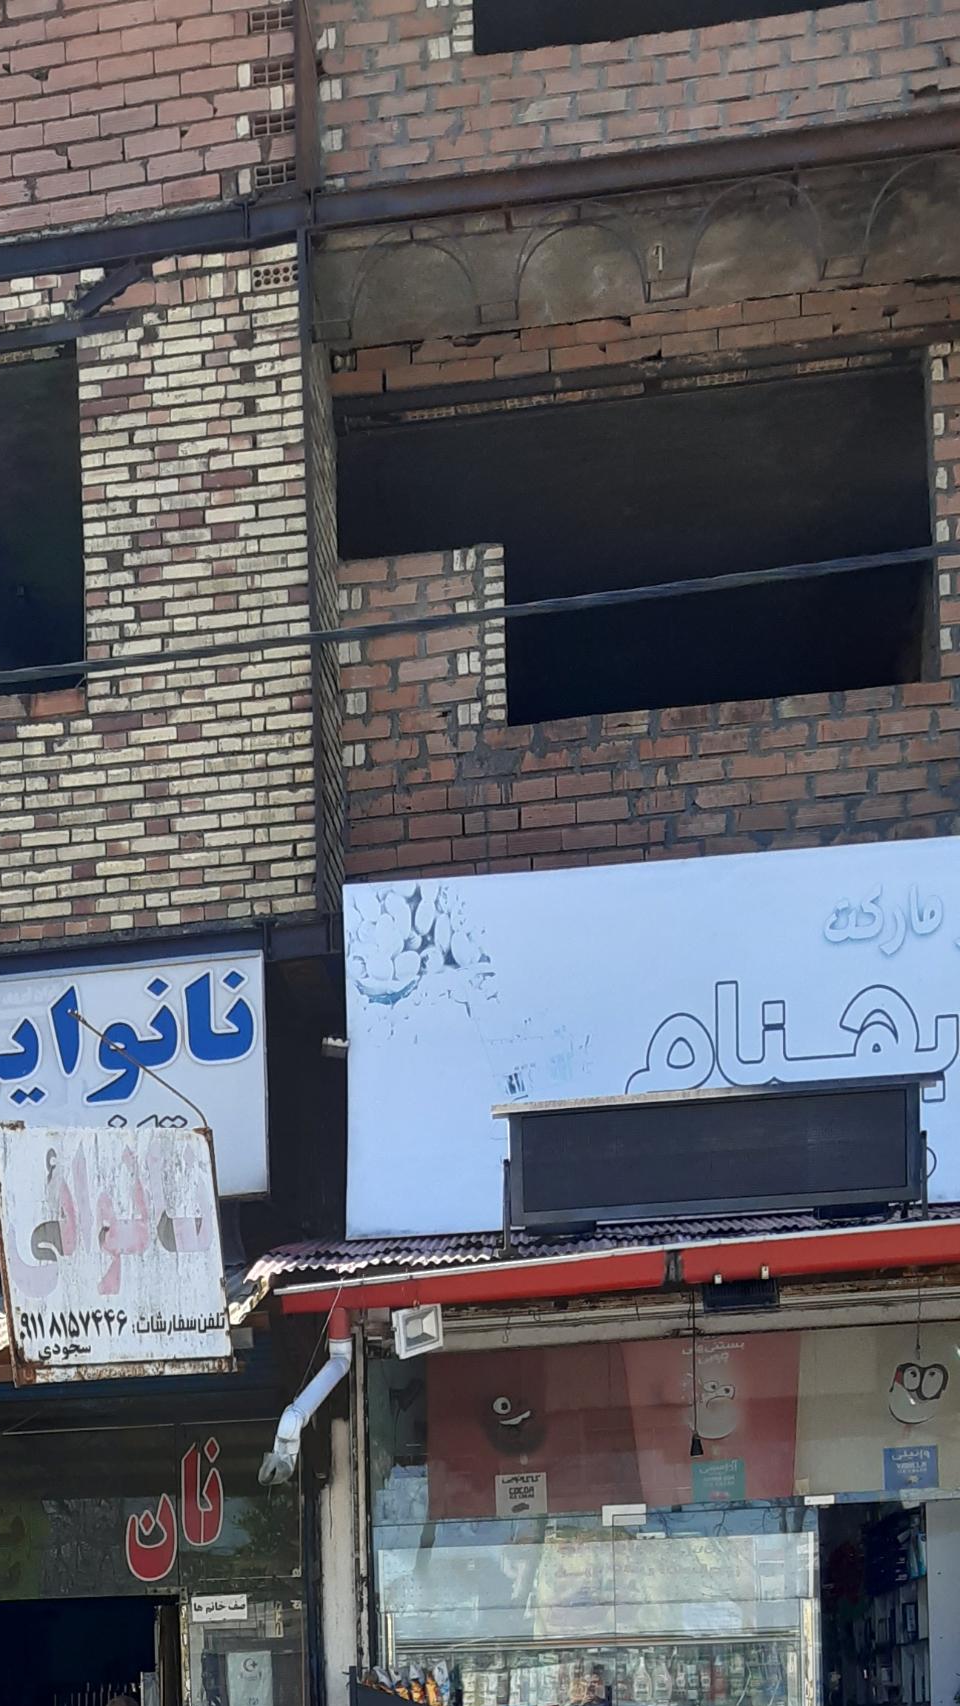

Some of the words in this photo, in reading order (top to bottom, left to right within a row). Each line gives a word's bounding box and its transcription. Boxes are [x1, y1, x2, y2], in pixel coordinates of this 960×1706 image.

[824, 883, 943, 955] مارکت
[198, 1312, 225, 1333] تلفن
[38, 1342, 91, 1361] سجودی
[125, 1437, 224, 1581] نان
[193, 1602, 203, 1612] ها
[205, 1601, 226, 1614] خانم
[228, 1600, 246, 1611] صف
